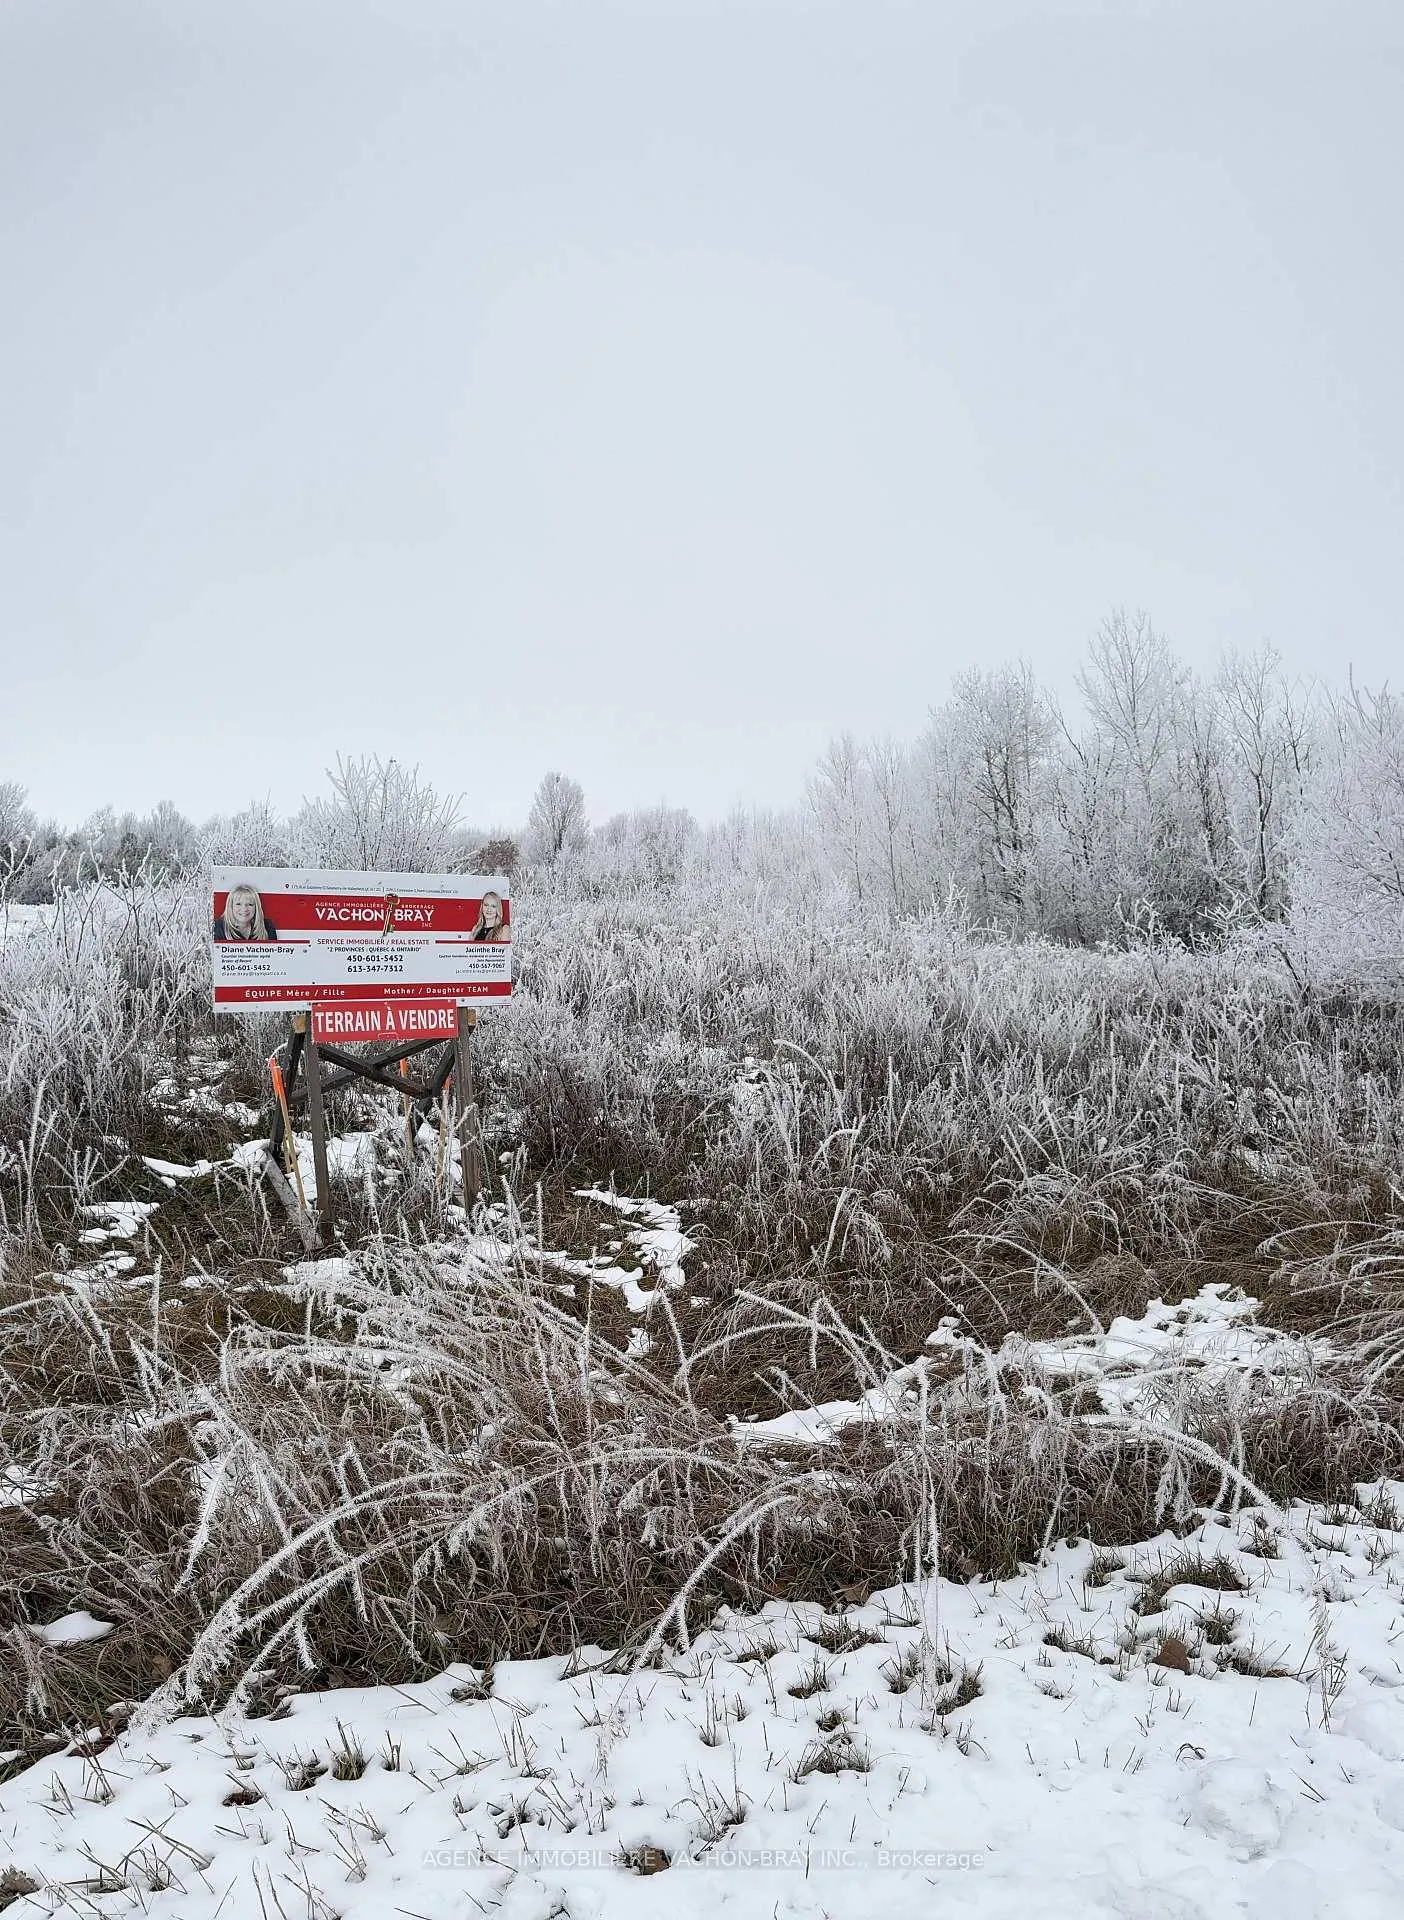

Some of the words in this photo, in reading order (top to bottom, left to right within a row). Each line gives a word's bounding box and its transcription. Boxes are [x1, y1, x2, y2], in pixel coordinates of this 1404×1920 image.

[315, 907, 384, 921] VACHON
[394, 908, 435, 922] BRAY
[246, 946, 294, 954] Vachon-Bray
[491, 946, 505, 954] Bray
[347, 965, 404, 973] 613-347-7312
[245, 989, 282, 998] ÉQUIPE
[286, 989, 310, 997] Mère
[314, 989, 319, 997] /
[384, 987, 415, 995] Mother
[426, 987, 464, 995] Daughter
[315, 1009, 381, 1033] TERRAIN
[385, 1006, 396, 1031] À
[398, 1008, 455, 1031] VENDRE
